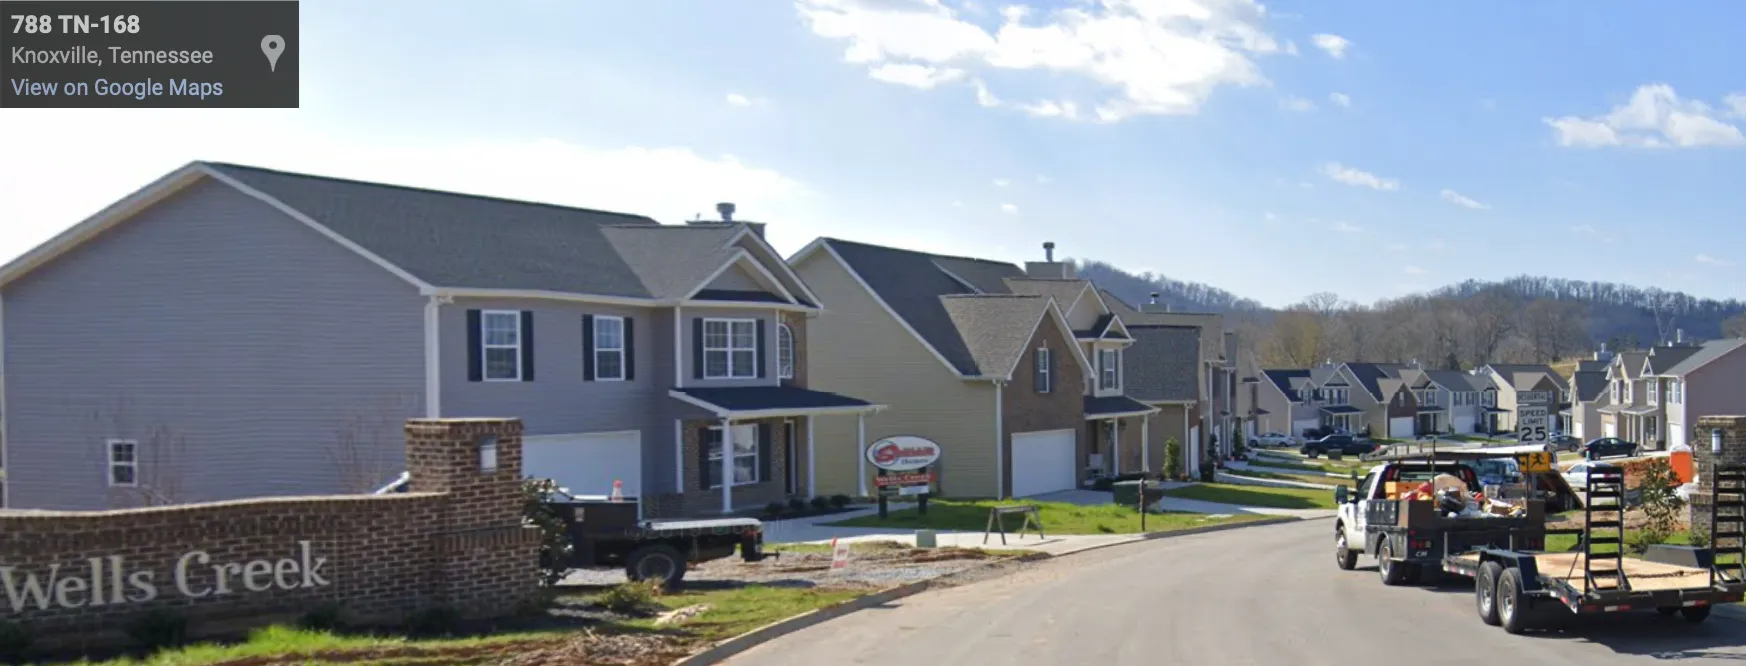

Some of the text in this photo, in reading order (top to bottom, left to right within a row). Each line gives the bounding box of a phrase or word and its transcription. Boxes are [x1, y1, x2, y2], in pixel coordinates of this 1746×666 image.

[1521, 426, 1546, 442] 25
[0, 540, 331, 614] Wells Creek
